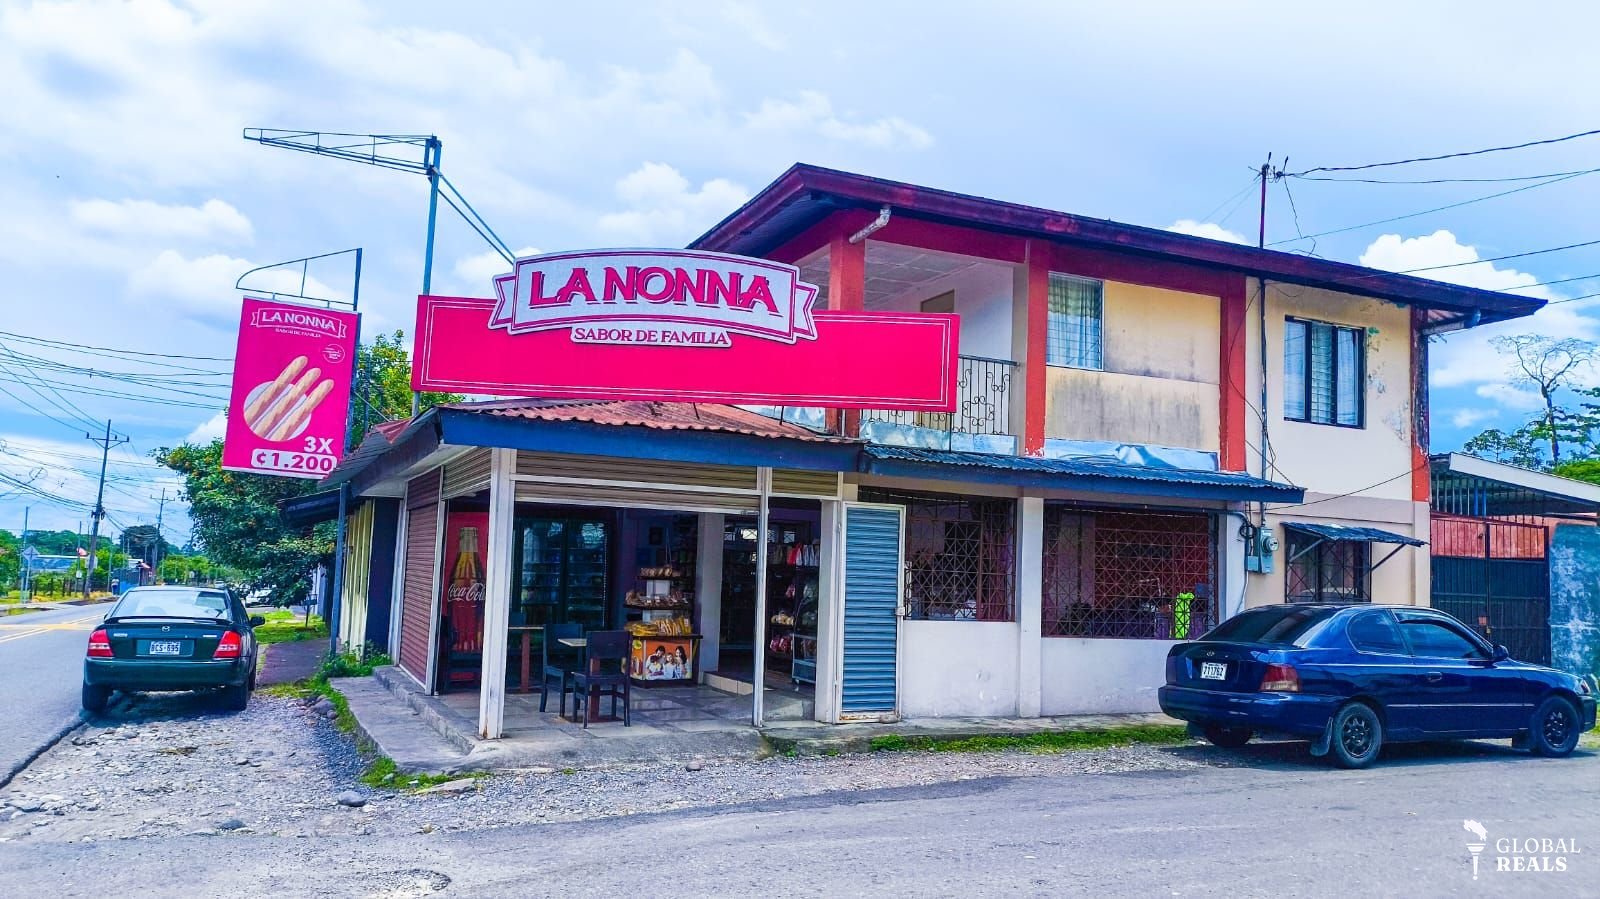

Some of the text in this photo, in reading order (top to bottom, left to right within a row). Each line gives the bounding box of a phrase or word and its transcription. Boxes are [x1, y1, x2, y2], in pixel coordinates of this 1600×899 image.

[528, 265, 783, 318] LA NONNA
[262, 311, 337, 333] LA NONNA
[574, 327, 728, 345] SABOR DE FAMILIA
[303, 436, 334, 455] 3X
